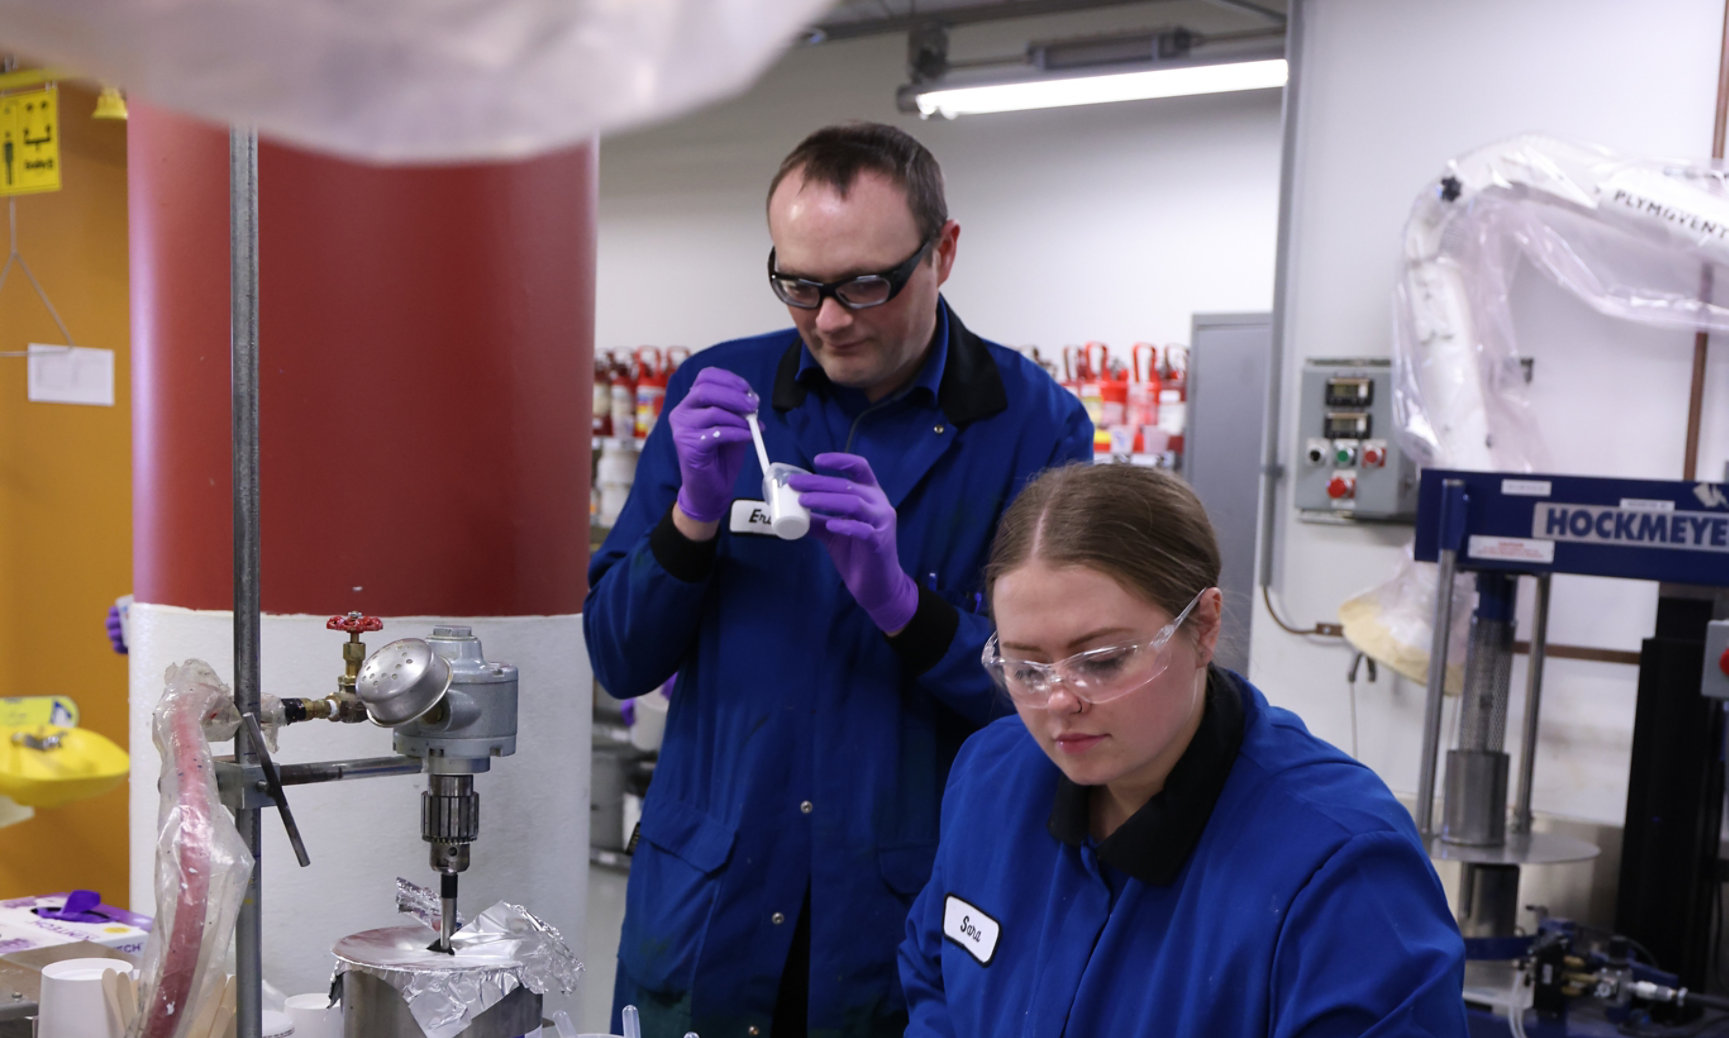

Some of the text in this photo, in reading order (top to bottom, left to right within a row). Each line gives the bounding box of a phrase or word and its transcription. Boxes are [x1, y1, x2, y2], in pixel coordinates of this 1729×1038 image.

[1614, 188, 1729, 238] PLYMOVENT
[1545, 507, 1728, 547] HOCKMEYE
[960, 915, 982, 943] Sara
